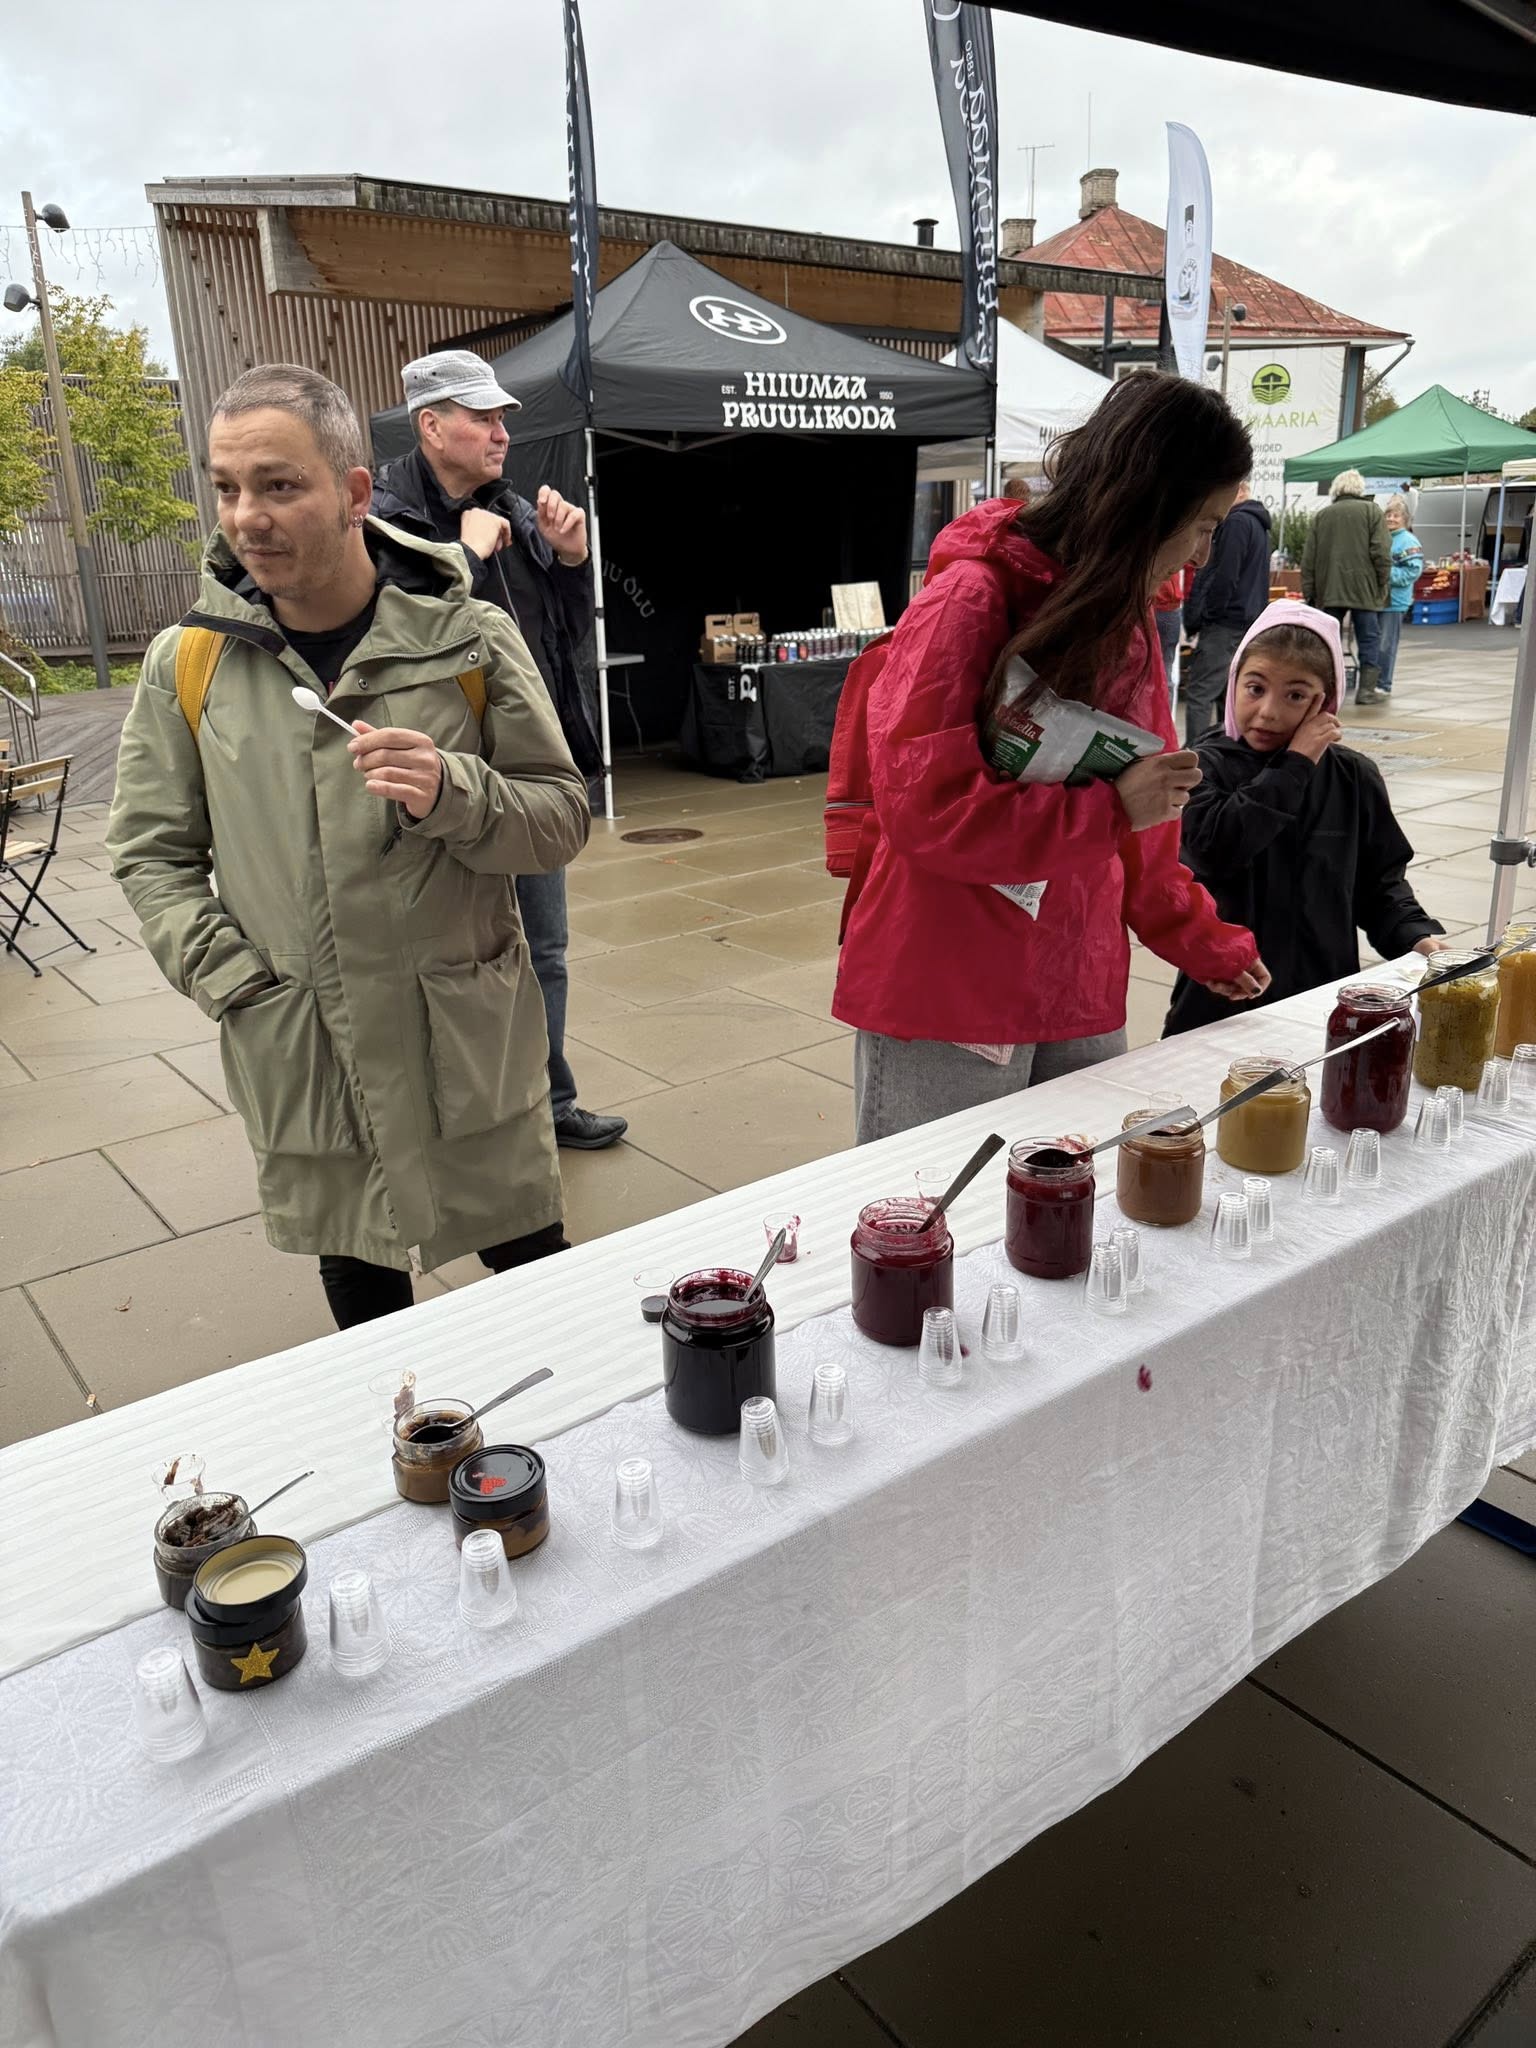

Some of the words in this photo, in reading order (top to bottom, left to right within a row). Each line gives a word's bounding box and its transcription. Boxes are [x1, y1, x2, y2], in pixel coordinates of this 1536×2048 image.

[721, 385, 737, 395] EST.
[744, 371, 867, 400] HIIUMAA
[722, 402, 896, 430] PRUULIKODA
